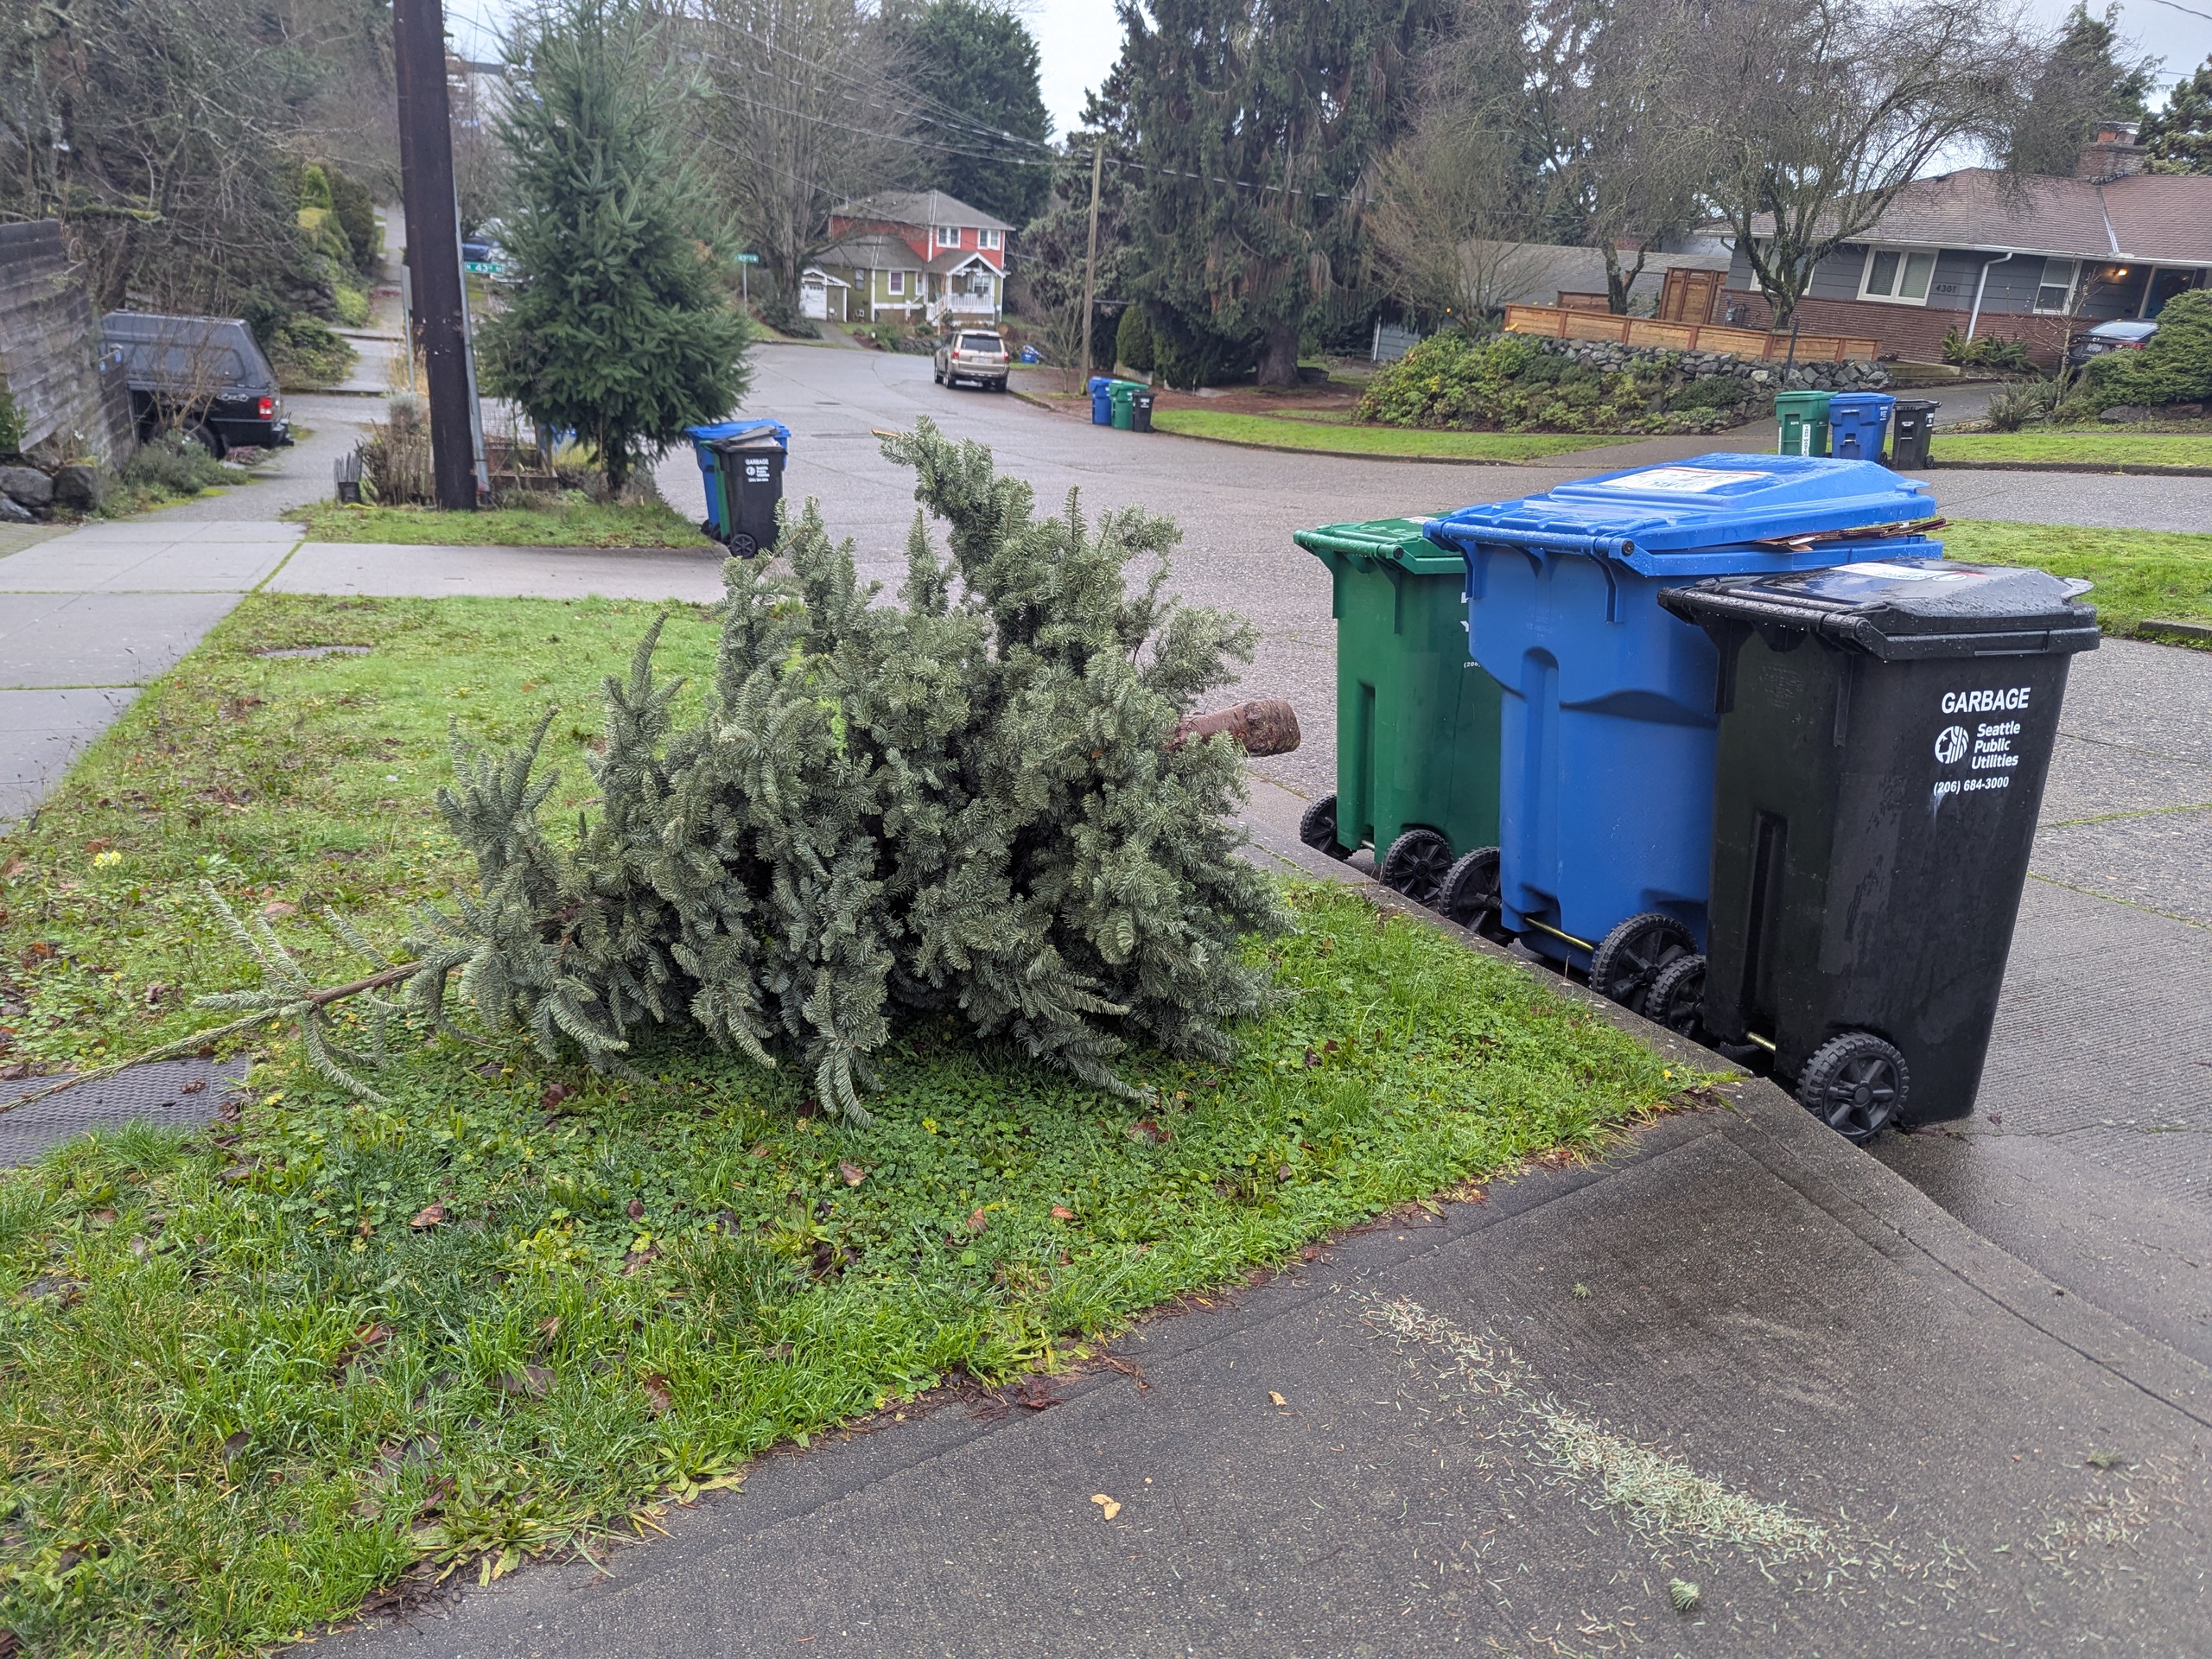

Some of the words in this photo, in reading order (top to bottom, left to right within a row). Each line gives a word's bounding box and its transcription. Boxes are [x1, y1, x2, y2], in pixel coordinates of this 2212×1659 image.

[1936, 284, 1956, 293] 4301
[1942, 687, 2031, 714] GARBAGE
[1976, 721, 2021, 737] Seattle
[1974, 738, 2011, 753] Public
[1971, 753, 2019, 770] Utilities
[1933, 780, 1961, 796] (206)
[1963, 776, 2010, 791] 684-3000
